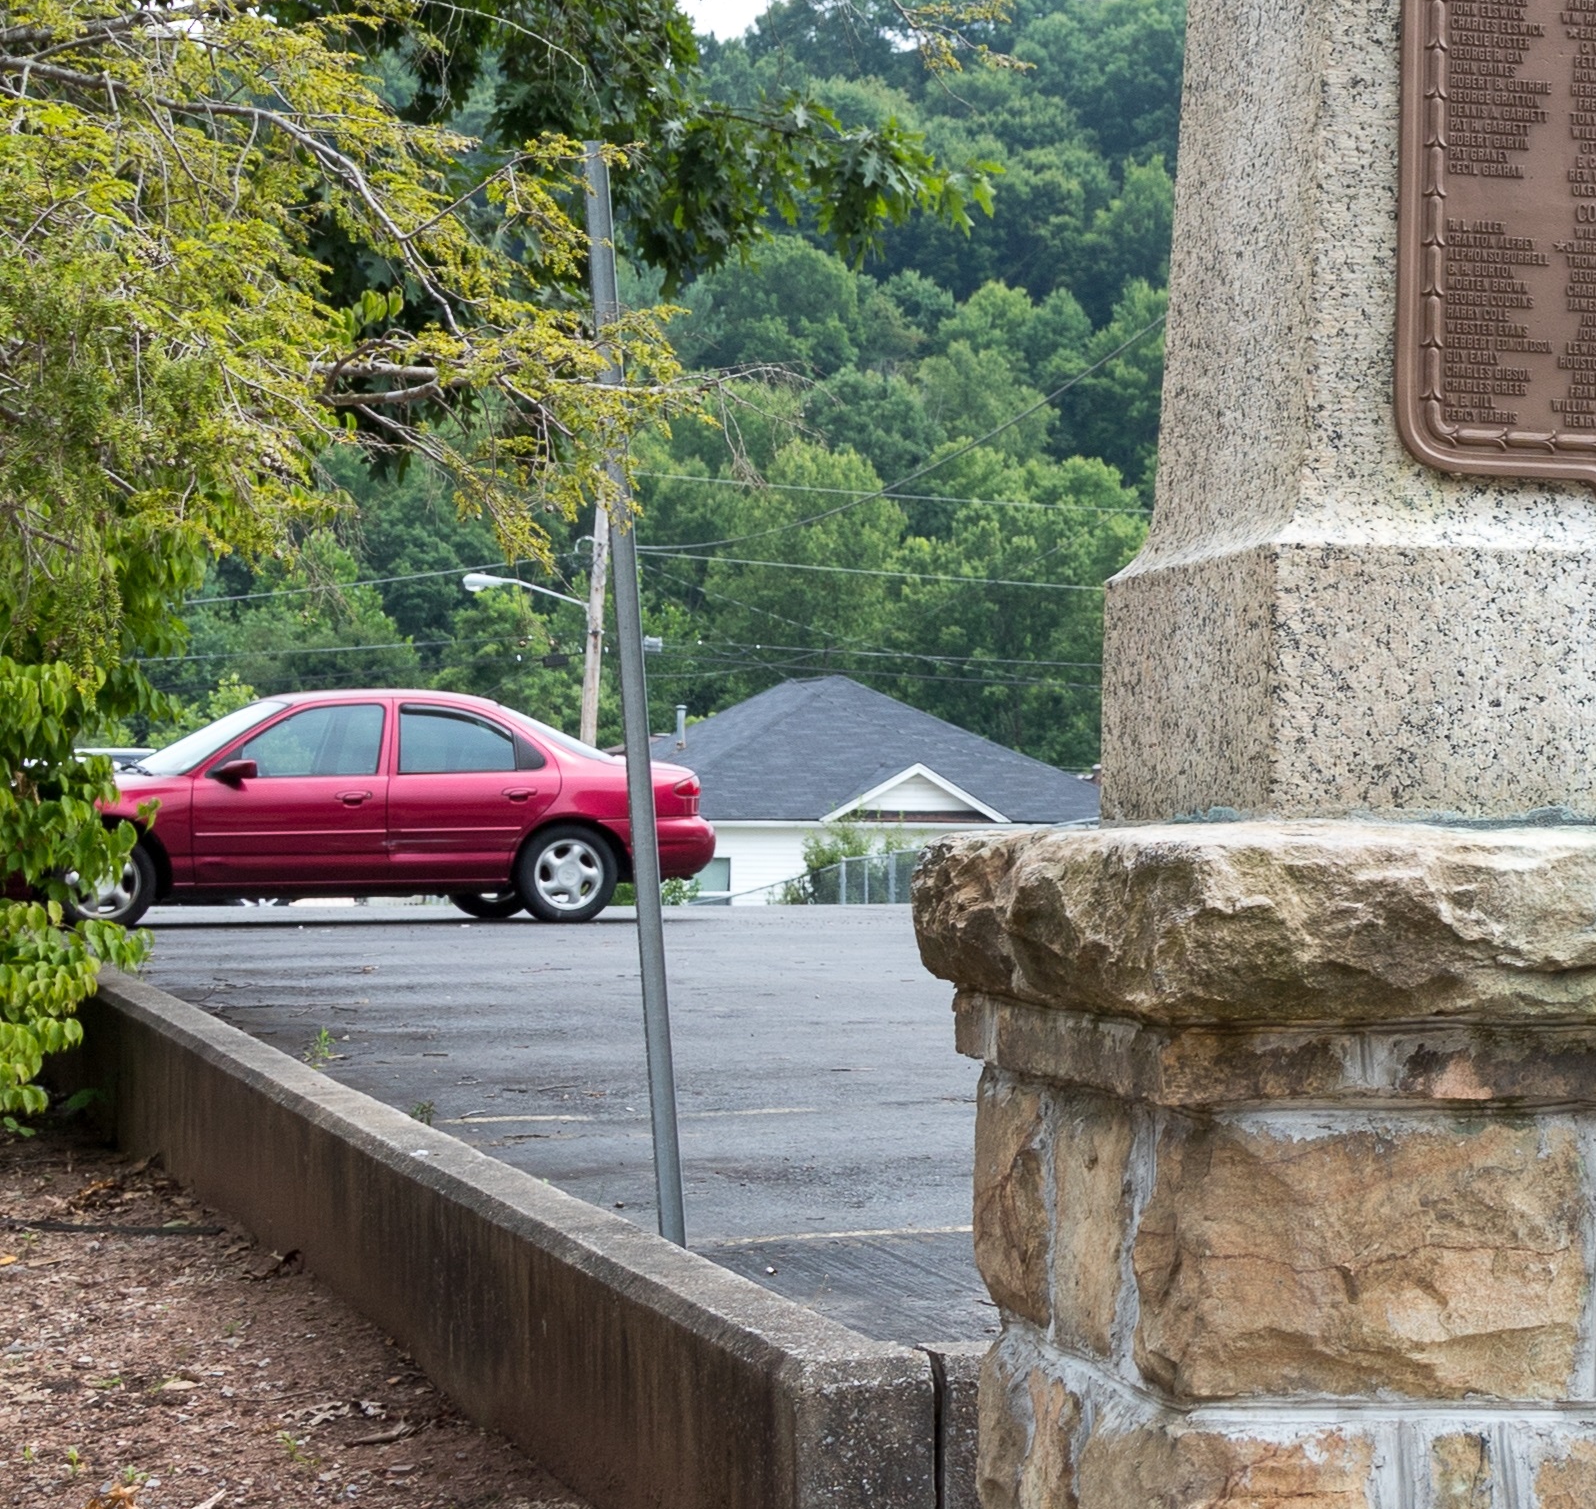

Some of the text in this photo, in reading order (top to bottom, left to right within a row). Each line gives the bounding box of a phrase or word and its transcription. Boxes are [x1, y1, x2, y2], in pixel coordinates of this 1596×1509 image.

[1451, 16, 1545, 36] CHARLES ELSWICK
[1451, 31, 1530, 49] WESLIE FOSTER
[1450, 89, 1539, 108] GEORGE GRATTON
[1449, 146, 1467, 160] PAT
[1449, 161, 1524, 178] CECIL GRAHAM
[1447, 247, 1549, 265] ALPHONSO BURRELL
[1446, 305, 1510, 321] HARRY COLE
[1446, 320, 1528, 337] WEBSTER EVANS
[1446, 349, 1500, 365] GUY EARLY
[1445, 378, 1527, 395] CHARLES GREER
[1445, 407, 1517, 424] PERCY HARRIS
